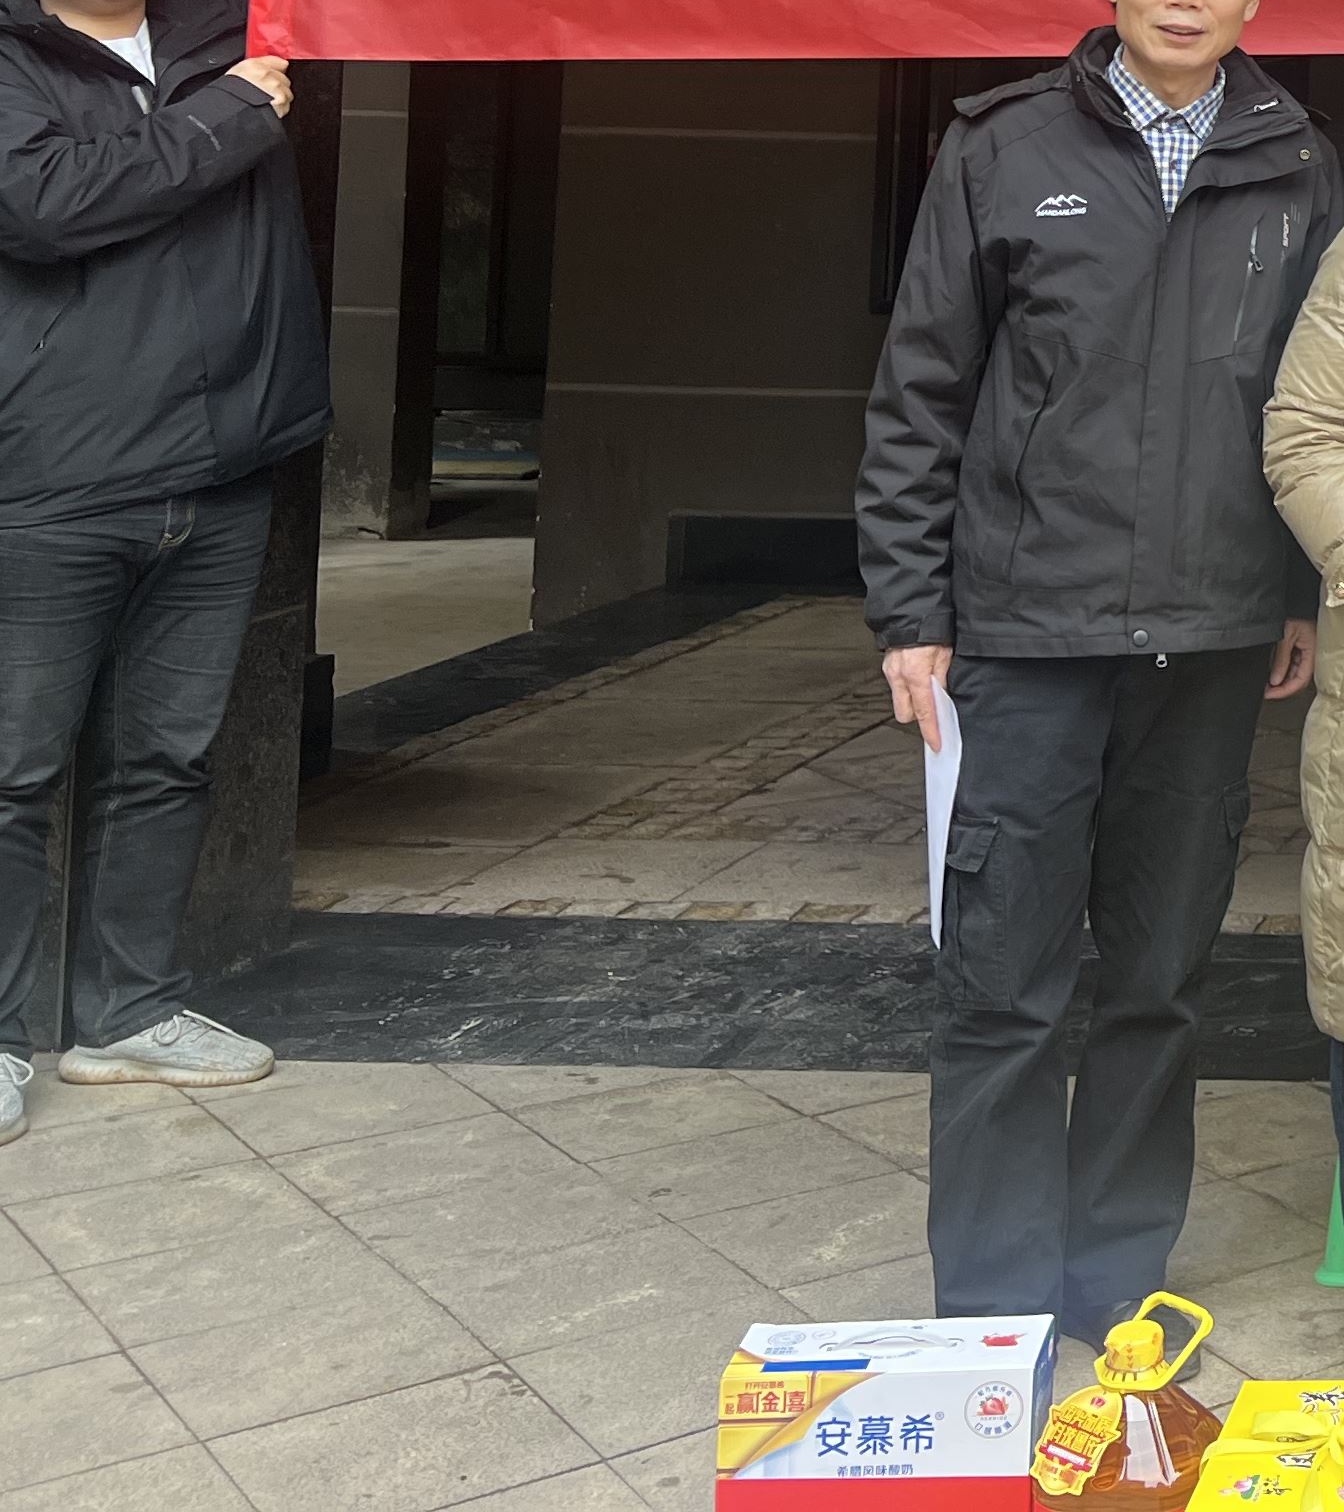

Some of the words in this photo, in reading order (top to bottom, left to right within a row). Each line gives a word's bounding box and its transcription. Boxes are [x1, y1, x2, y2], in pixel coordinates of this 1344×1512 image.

[816, 1414, 935, 1457] 安慕希
[837, 1464, 914, 1477] 希腊风味酸奶
